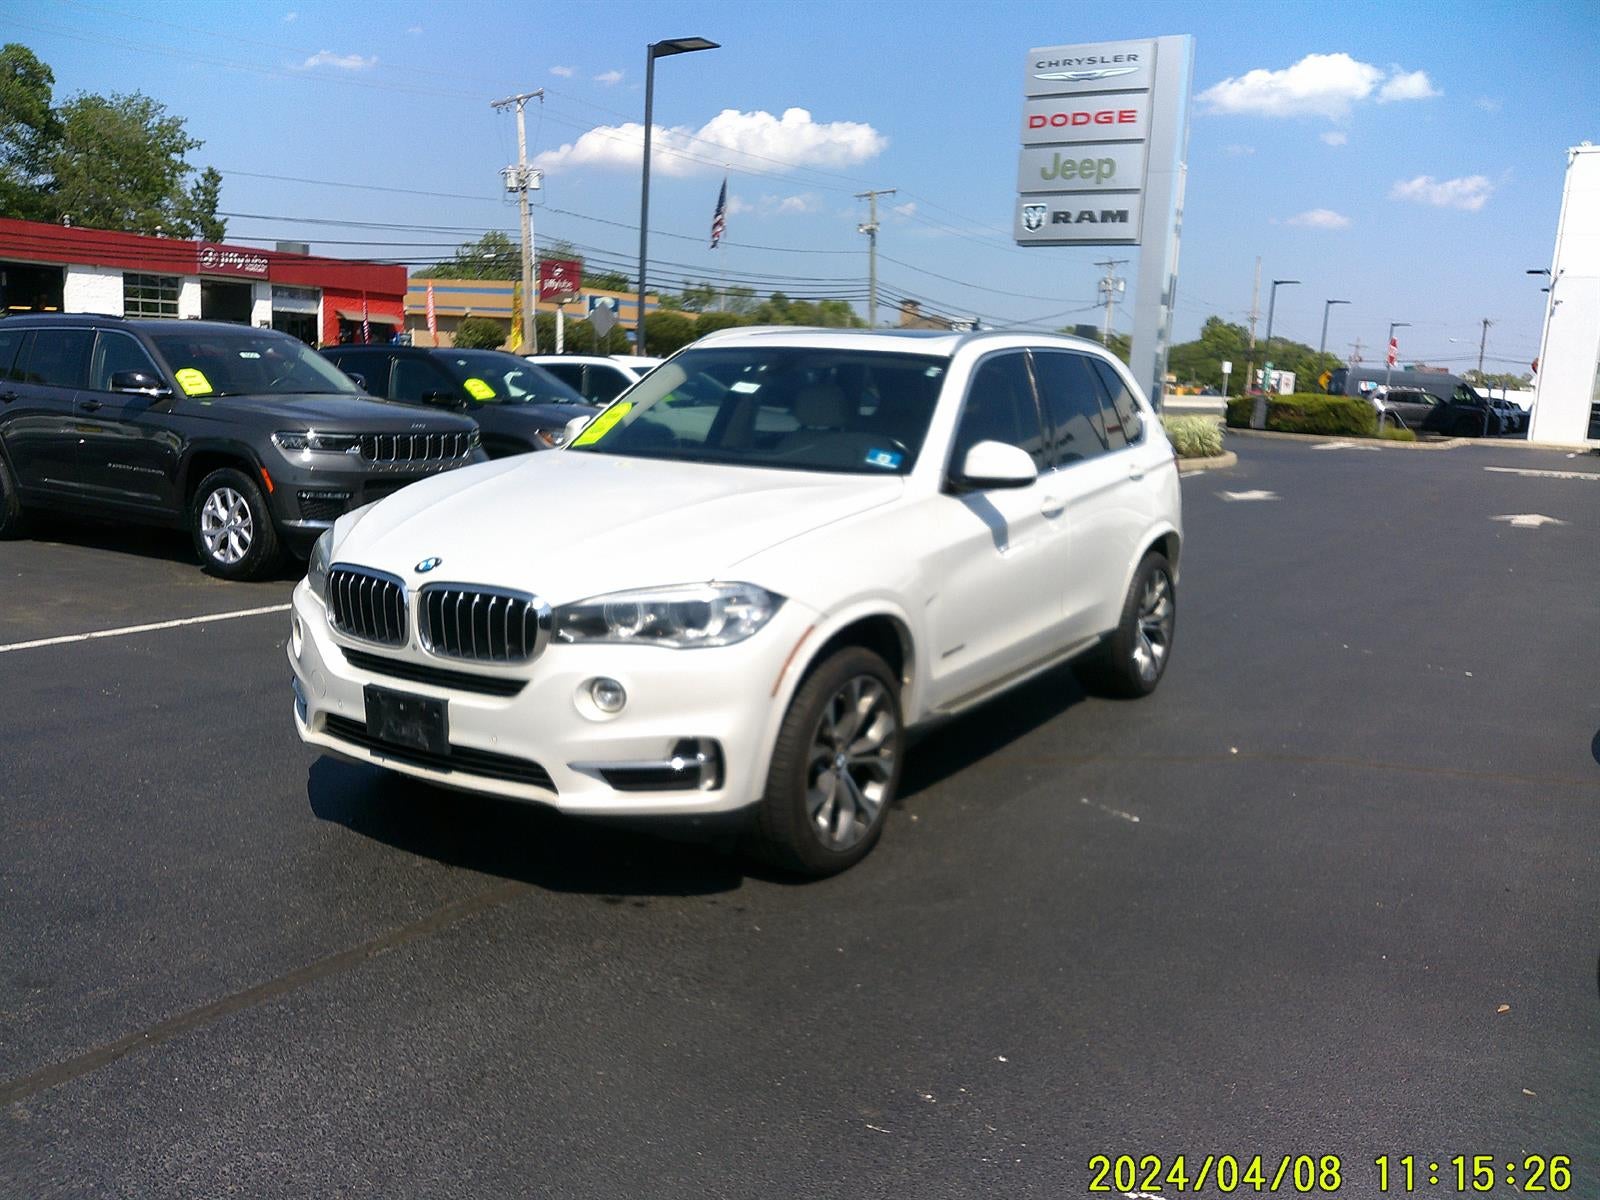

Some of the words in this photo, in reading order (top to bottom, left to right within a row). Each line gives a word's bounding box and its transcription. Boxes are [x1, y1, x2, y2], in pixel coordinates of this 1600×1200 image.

[1035, 54, 1139, 69] CHRYSLER
[1029, 110, 1137, 129] DODGE
[1041, 153, 1116, 184] Jeep
[1052, 209, 1129, 224] RAM
